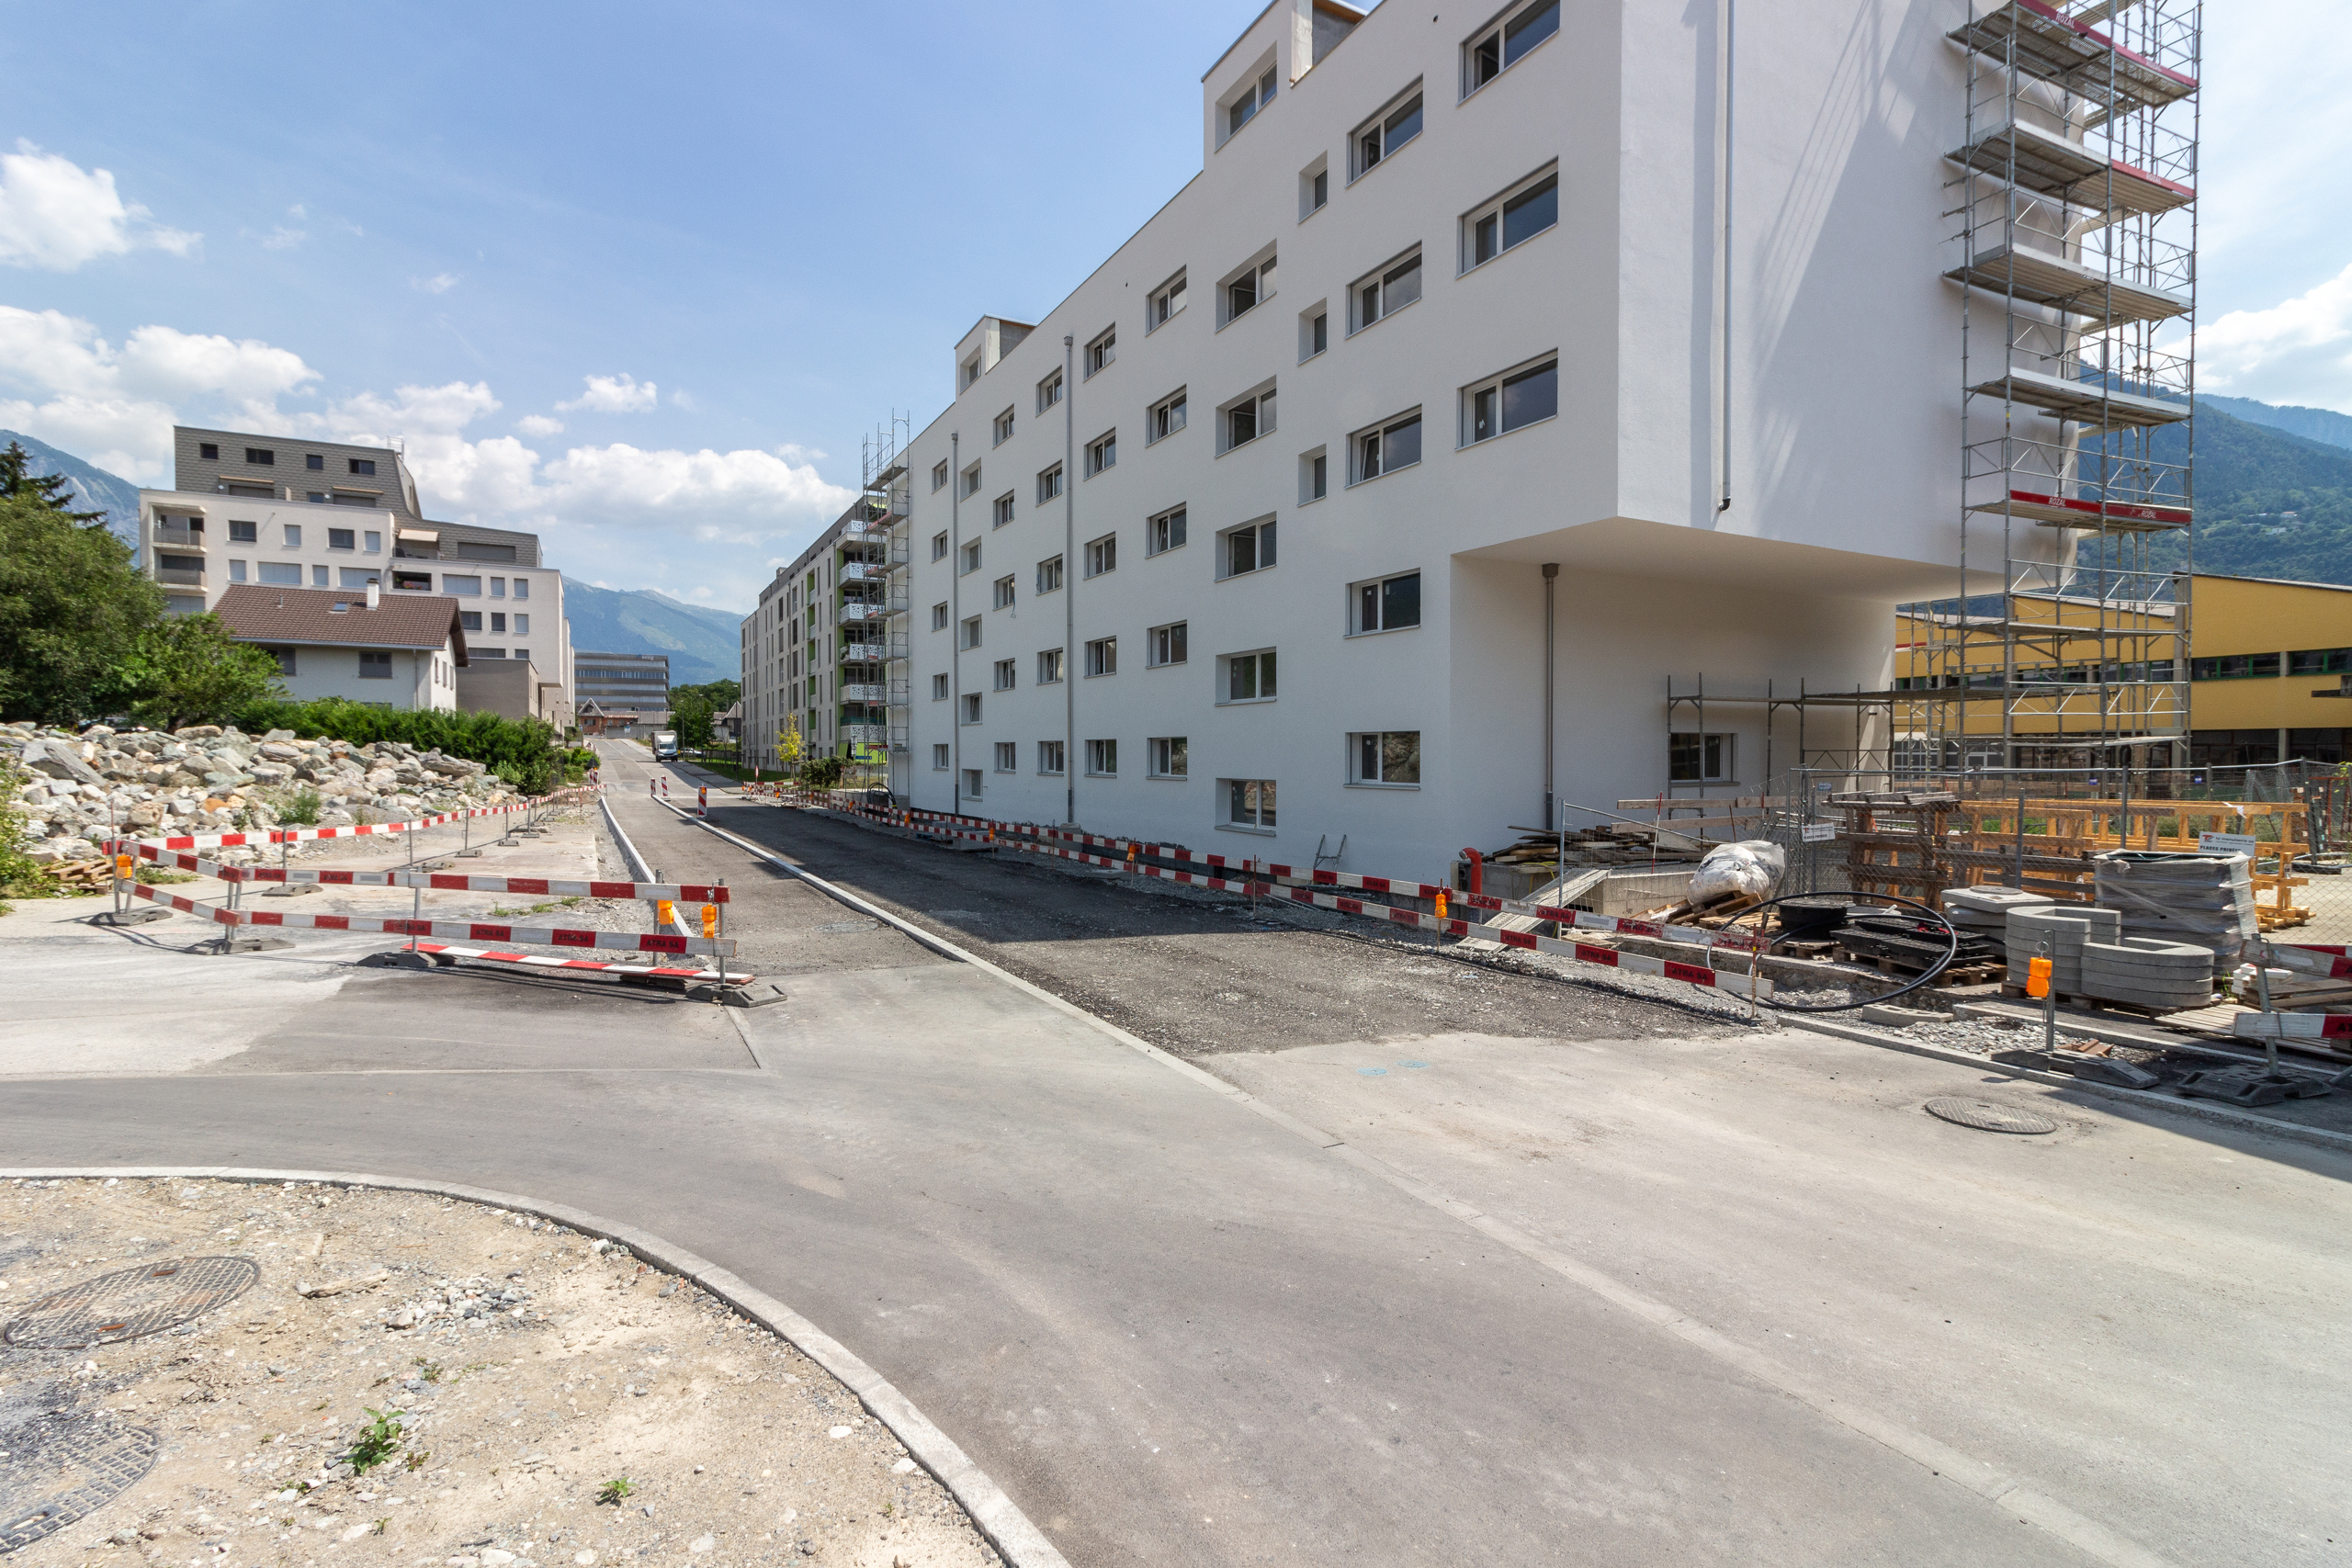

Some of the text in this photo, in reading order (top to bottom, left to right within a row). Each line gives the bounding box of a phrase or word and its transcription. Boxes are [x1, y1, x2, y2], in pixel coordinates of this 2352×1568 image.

[2048, 497, 2066, 507] ROZAL
[558, 933, 577, 942] ATRA
[1506, 934, 1521, 942] ATRA
[646, 939, 666, 947] ATRA
[1581, 950, 1611, 962] ATRA SA
[1671, 968, 1707, 980] ATRA SA
